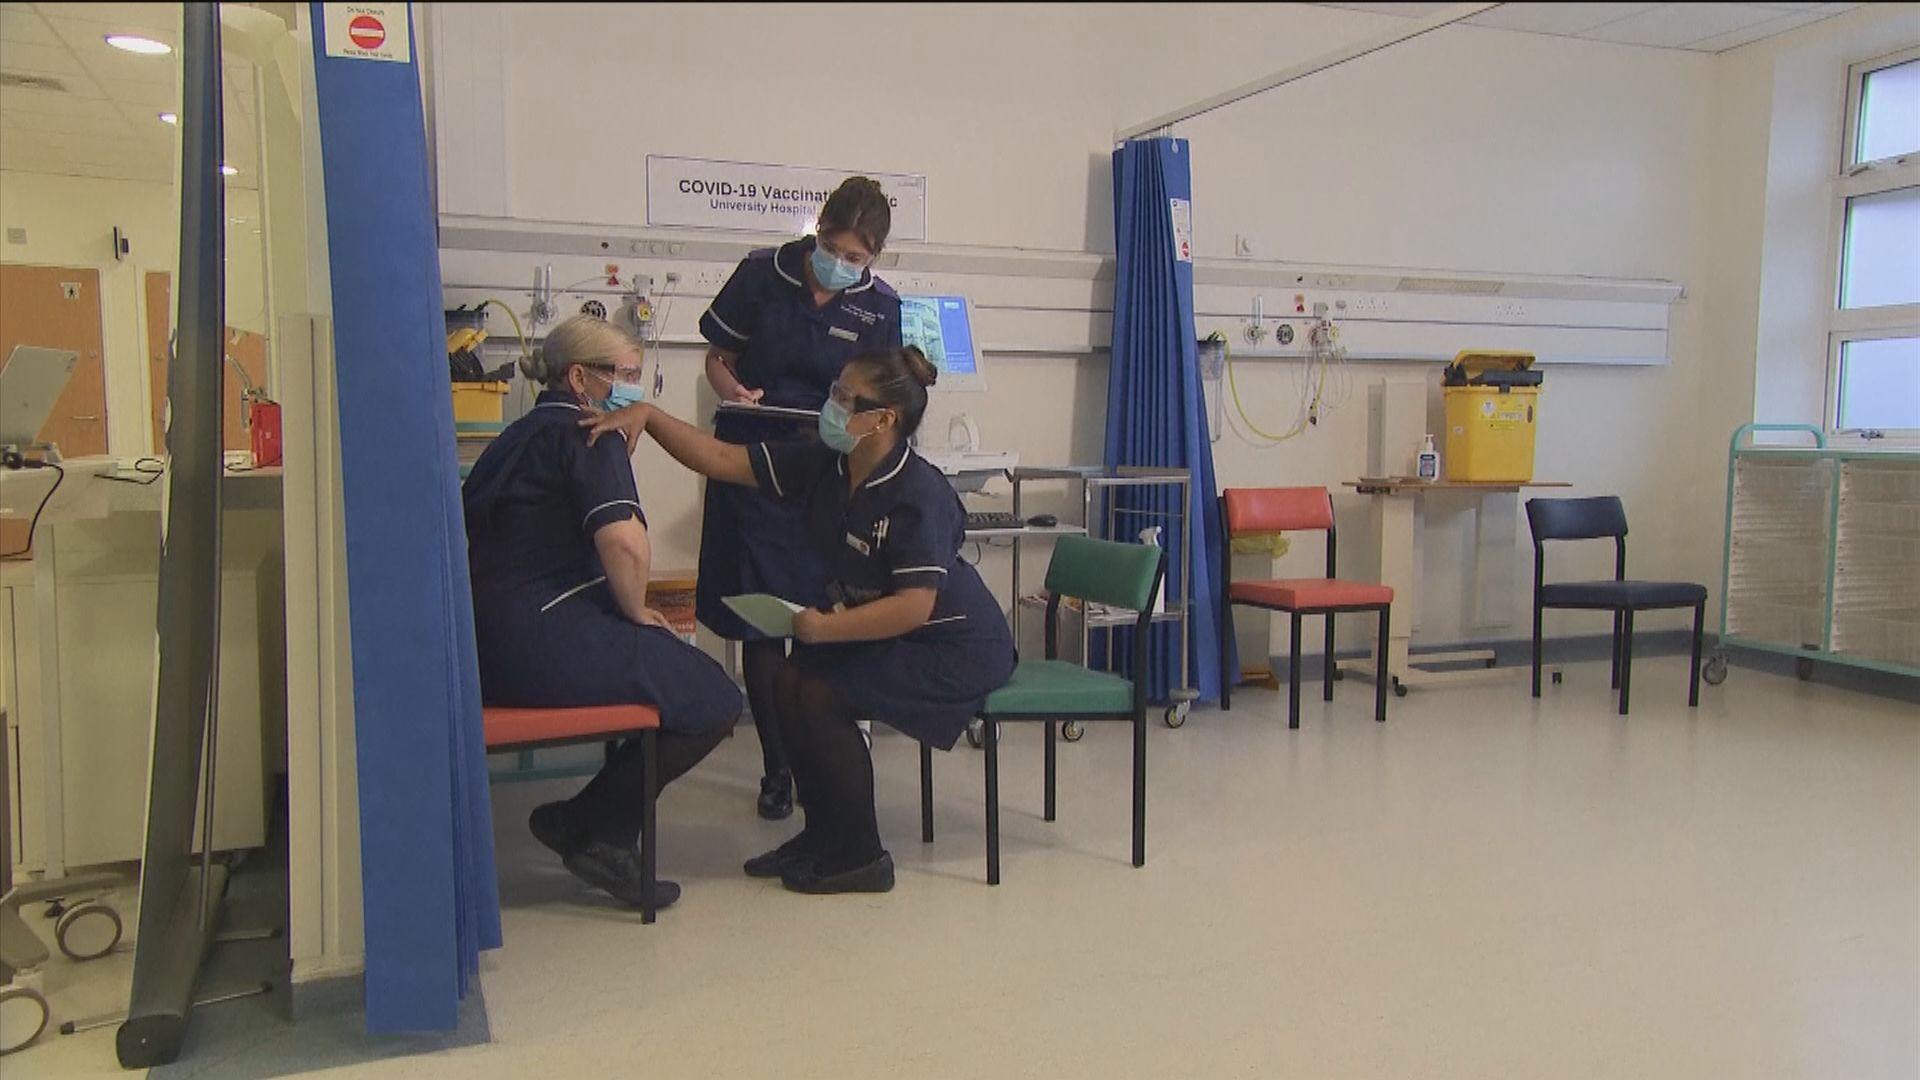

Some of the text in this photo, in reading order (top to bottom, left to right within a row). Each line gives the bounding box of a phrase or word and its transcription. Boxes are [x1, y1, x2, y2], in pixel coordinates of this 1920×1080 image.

[679, 179, 829, 203] COVID-19 Vaccinat
[710, 198, 816, 217] University Hospital
